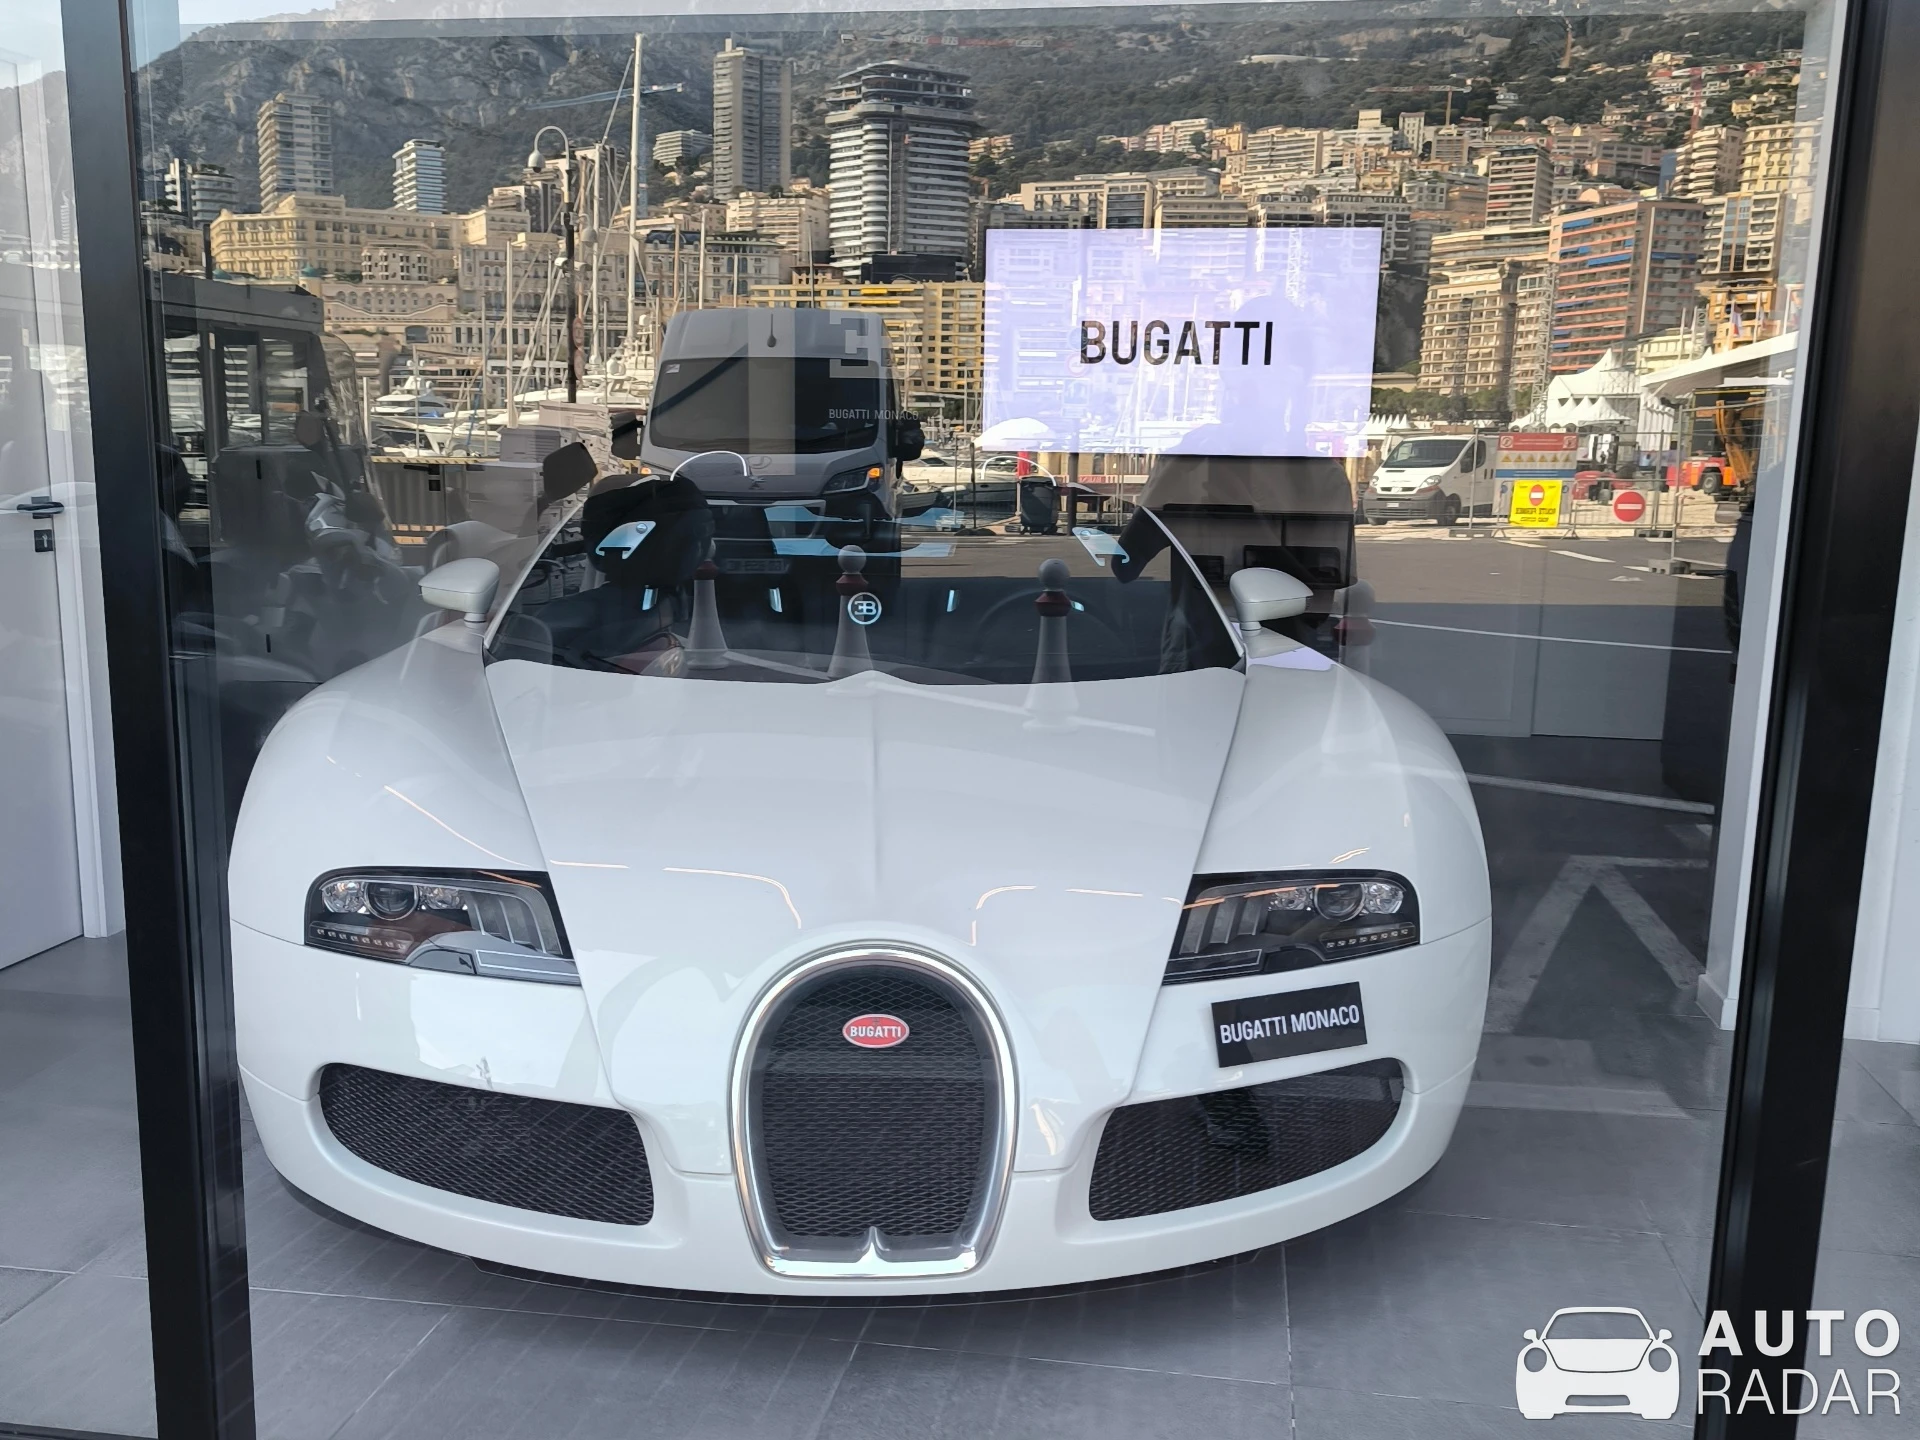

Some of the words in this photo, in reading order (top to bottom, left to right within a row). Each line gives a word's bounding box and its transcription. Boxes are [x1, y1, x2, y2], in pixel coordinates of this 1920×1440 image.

[1079, 320, 1274, 366] BUGATTI
[828, 408, 870, 419] BUGATTI
[874, 409, 919, 420] MONACO
[850, 1026, 902, 1038] BUGATTI
[1220, 1015, 1288, 1044] BUGATTI
[1291, 1004, 1360, 1033] MONACO
